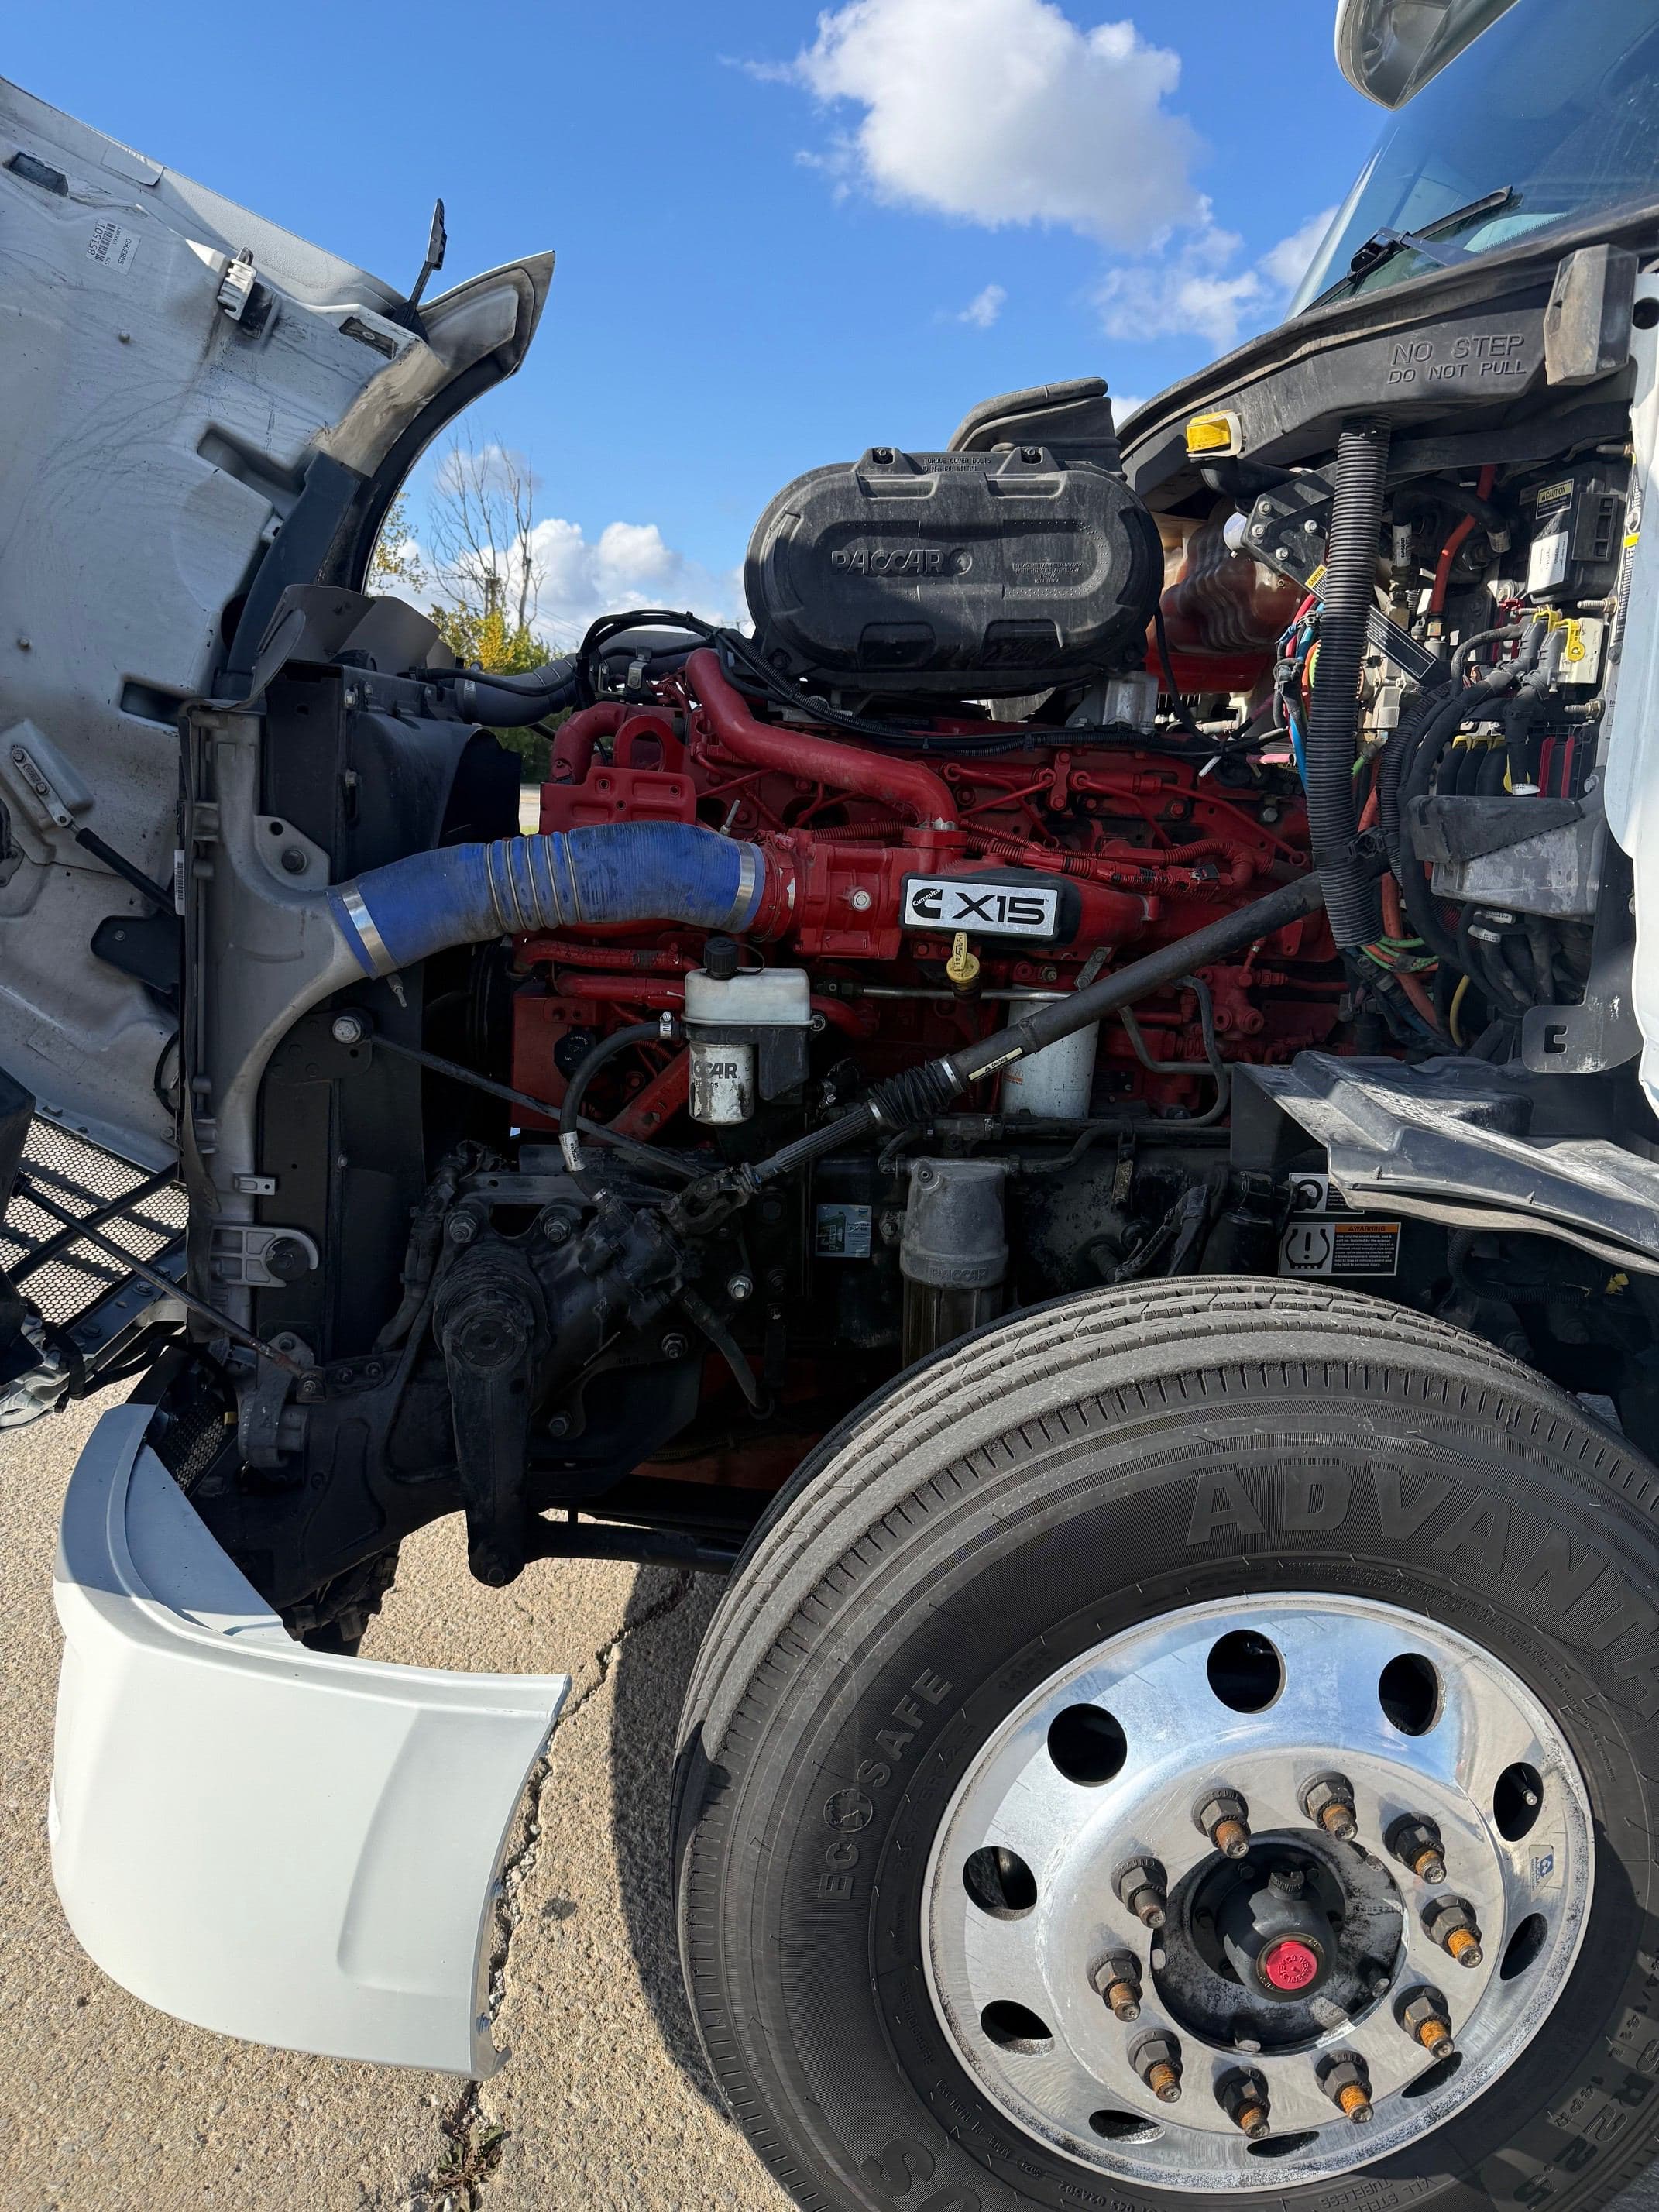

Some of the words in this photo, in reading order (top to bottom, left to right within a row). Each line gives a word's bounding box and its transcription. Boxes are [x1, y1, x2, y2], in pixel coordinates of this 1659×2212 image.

[87, 222, 106, 256] 851501
[1391, 340, 1434, 366] NO
[1451, 334, 1525, 359] STEP
[1387, 369, 1417, 385] DO
[1429, 364, 1469, 380] NOT
[1480, 359, 1527, 376] PULL
[1546, 486, 1566, 499] CAUTION
[831, 549, 945, 576] PACCAR
[1309, 568, 1325, 586] CAUTION
[912, 888, 942, 907] Cummins
[952, 891, 1046, 925] X15
[1318, 2178, 1393, 2209] TUBELESS
